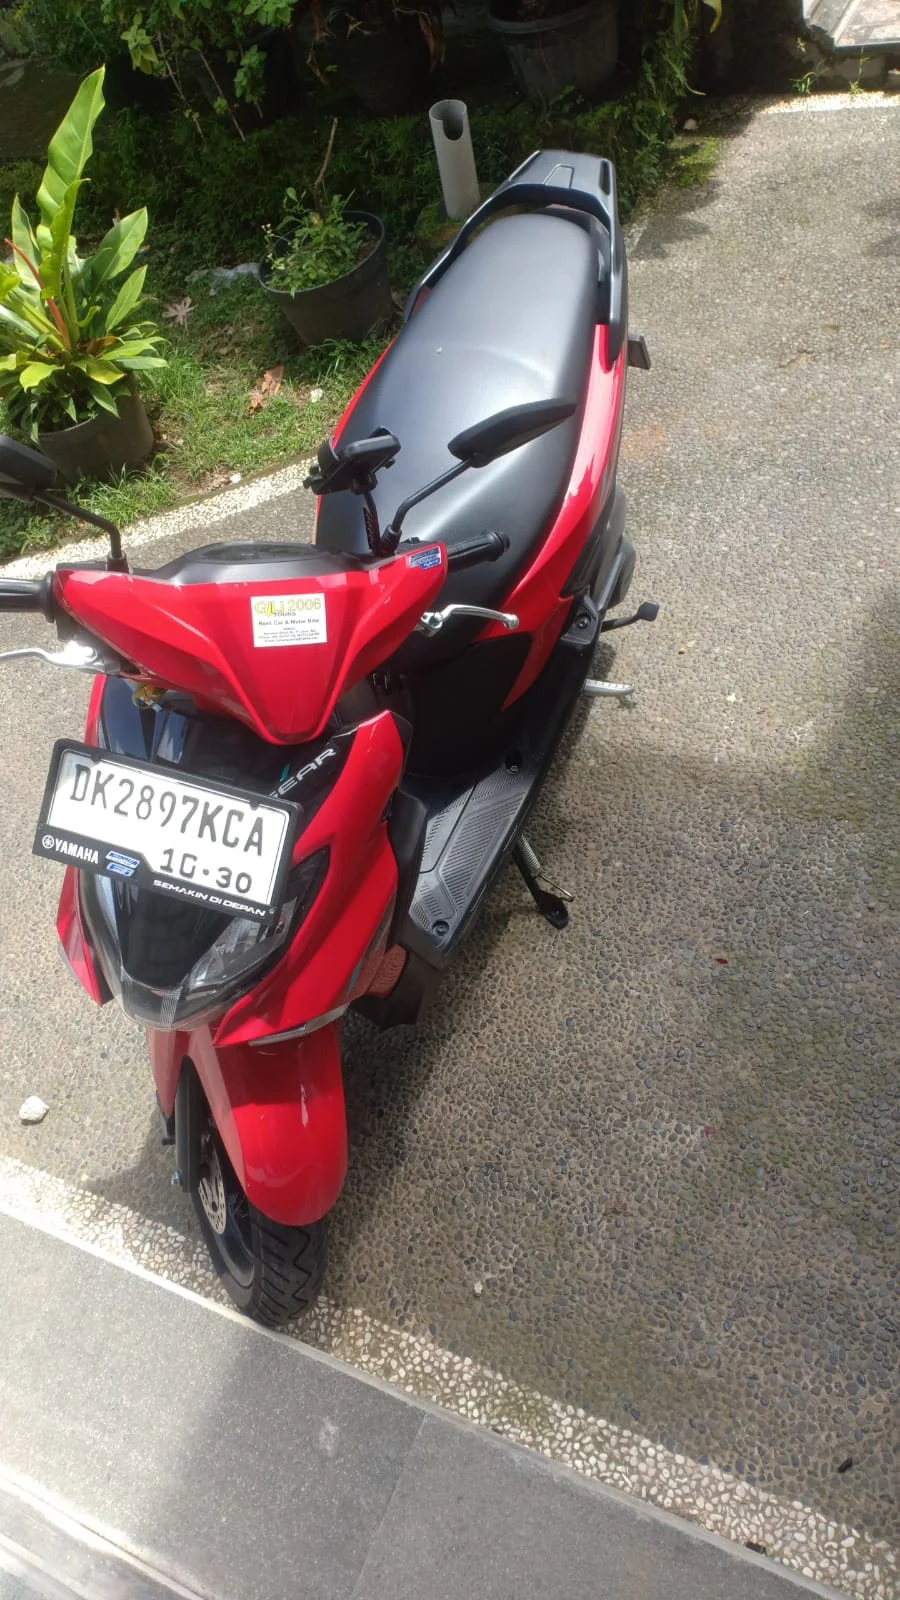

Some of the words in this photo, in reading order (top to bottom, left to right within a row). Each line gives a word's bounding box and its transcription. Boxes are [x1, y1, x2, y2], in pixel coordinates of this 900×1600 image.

[287, 598, 321, 612] 2006
[55, 838, 99, 864] YAMAHA
[153, 880, 208, 900] SEMAKIN
[209, 897, 222, 905] DI
[223, 901, 266, 917] DEPAN
